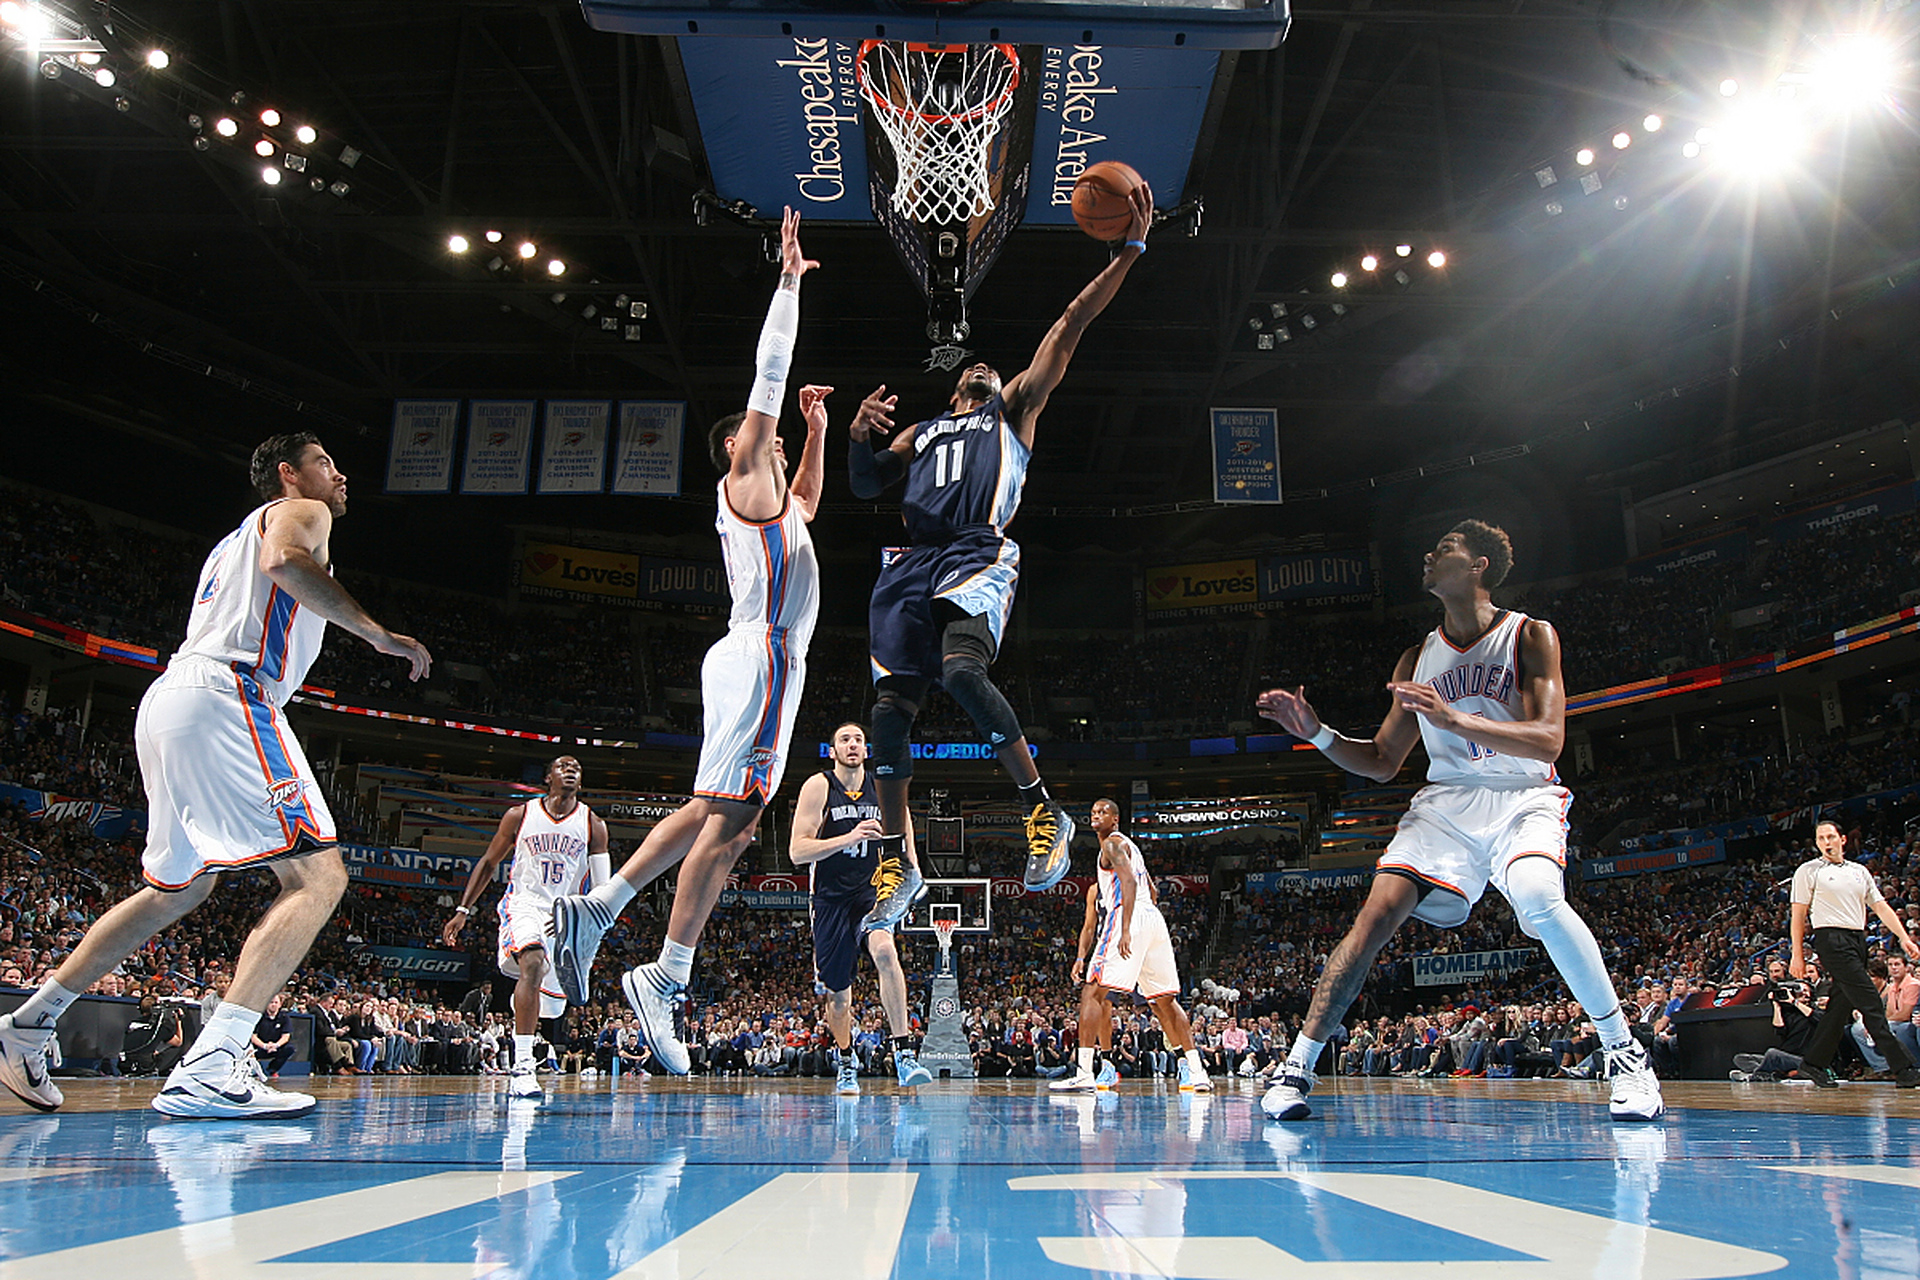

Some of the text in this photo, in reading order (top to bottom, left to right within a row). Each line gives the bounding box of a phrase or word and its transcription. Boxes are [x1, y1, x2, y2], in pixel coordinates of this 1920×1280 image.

[835, 41, 857, 108] ENERGY
[1041, 46, 1063, 112] ENERGY
[935, 439, 966, 488] 11
[1805, 503, 1880, 530] THUNDER
[1655, 550, 1718, 573] THUNDER
[649, 566, 728, 596] LOUD CIT
[1266, 557, 1363, 595] LOUD CITY
[520, 585, 564, 599] BRING
[567, 589, 595, 603] THE
[600, 594, 664, 611] THUNDER
[684, 603, 714, 614] EXIT
[1147, 593, 1372, 620] BRING THE THUNDER EXIT NOW
[1157, 808, 1280, 825] RIVERWIND CASINO
[523, 834, 586, 860] THUNDER
[540, 860, 565, 884] 15
[1591, 862, 1616, 875] Text
[1677, 852, 1688, 864] to
[994, 883, 1022, 897] KIA
[1193, 875, 1210, 885] 101
[1246, 873, 1265, 883] 102
[758, 894, 792, 905] Tuition
[402, 956, 466, 973] LIGHT
